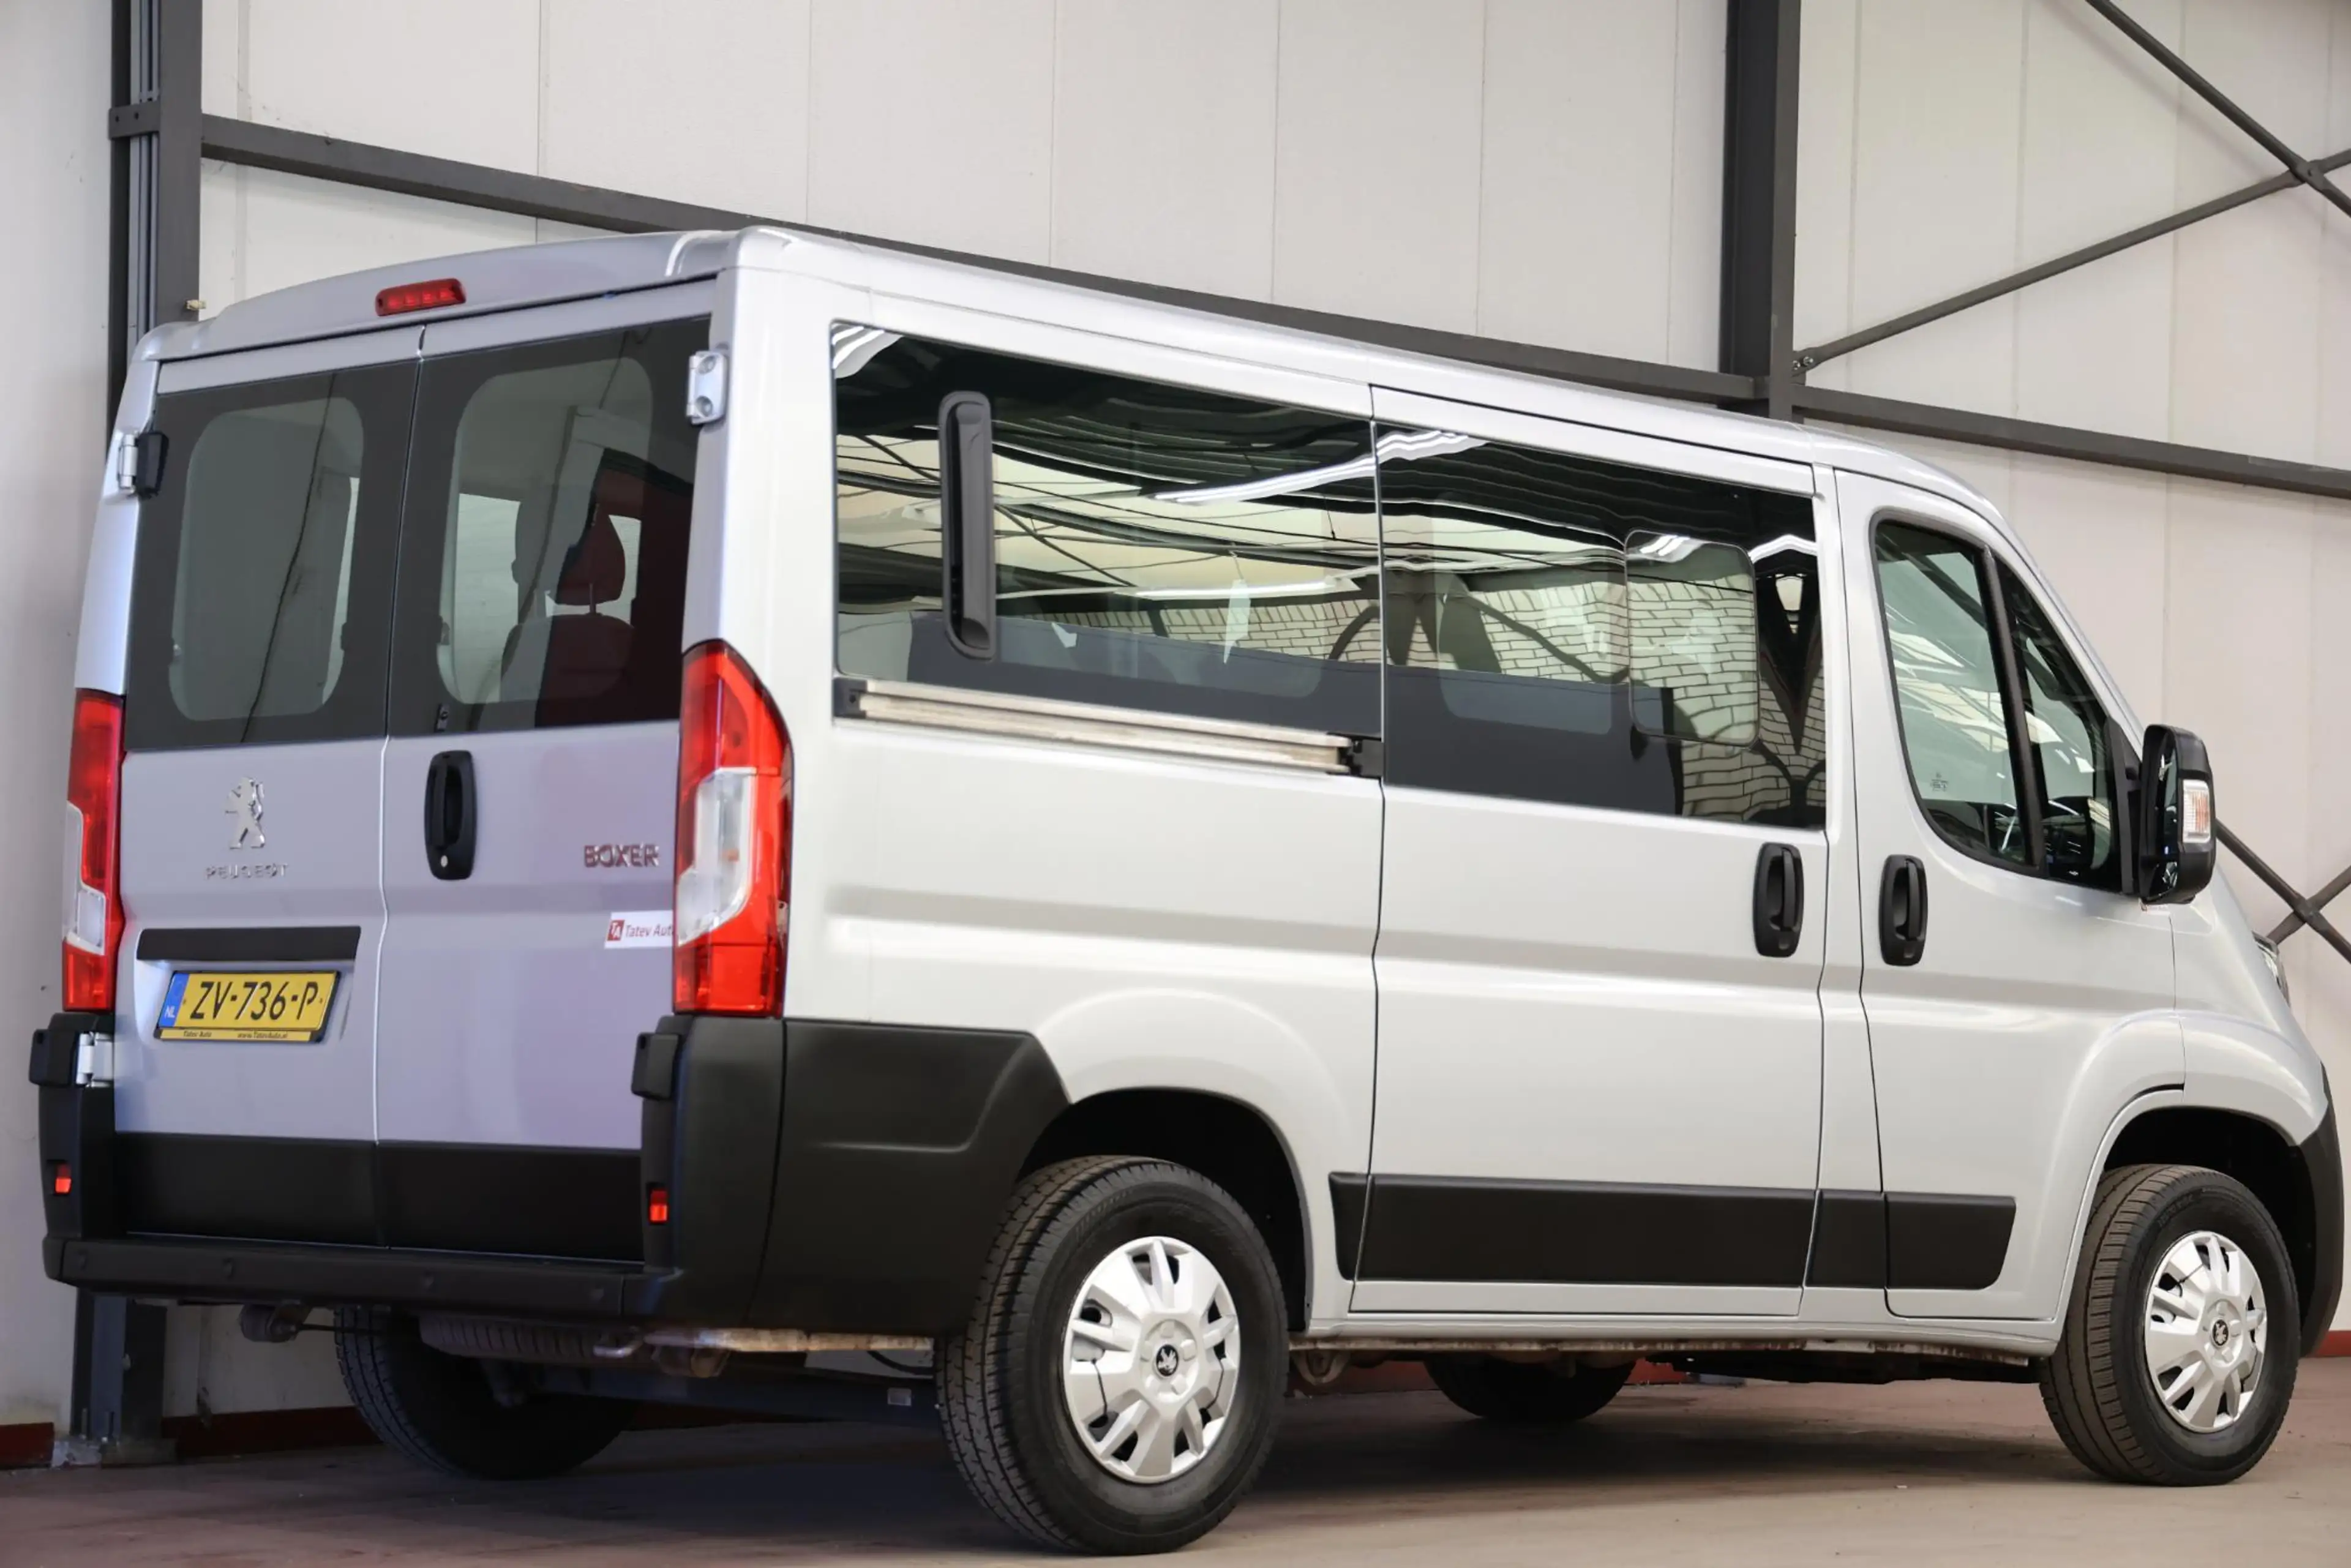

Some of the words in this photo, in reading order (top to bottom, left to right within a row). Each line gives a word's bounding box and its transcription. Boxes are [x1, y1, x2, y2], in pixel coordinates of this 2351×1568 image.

[584, 843, 659, 868] BOXER
[205, 863, 288, 880] PEUGEOT
[626, 924, 651, 937] Tatev
[190, 981, 318, 1021] ZV-736-P
